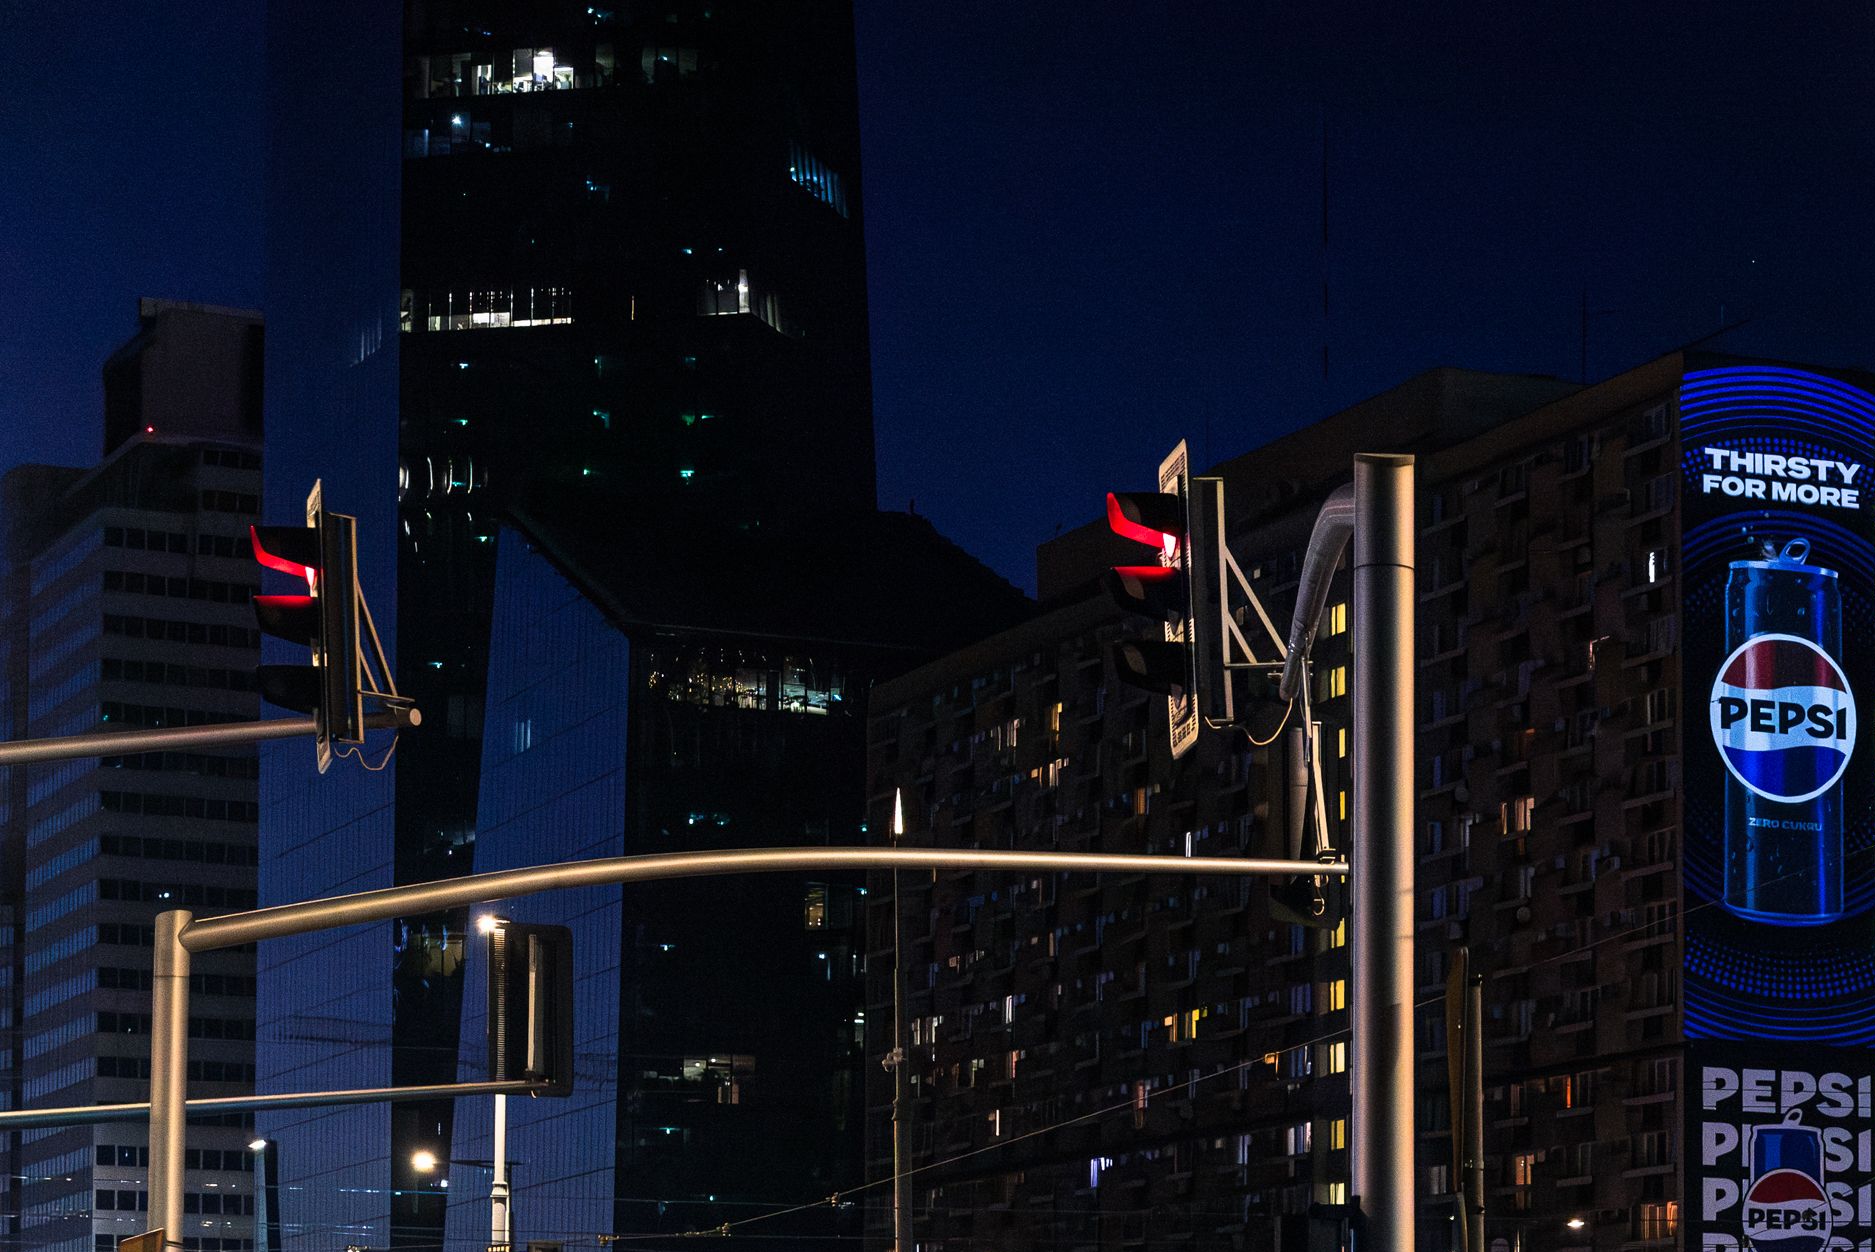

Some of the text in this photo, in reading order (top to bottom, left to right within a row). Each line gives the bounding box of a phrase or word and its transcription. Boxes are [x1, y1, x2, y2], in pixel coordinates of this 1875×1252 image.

[1704, 447, 1861, 484] THIRSTY
[1703, 473, 1860, 509] FOR MORE
[1718, 696, 1847, 741] PEPSI
[1748, 817, 1823, 832] ZERO CUKRU
[1702, 1066, 1872, 1118] PEPSI
[1748, 1208, 1827, 1232] PEPSI
